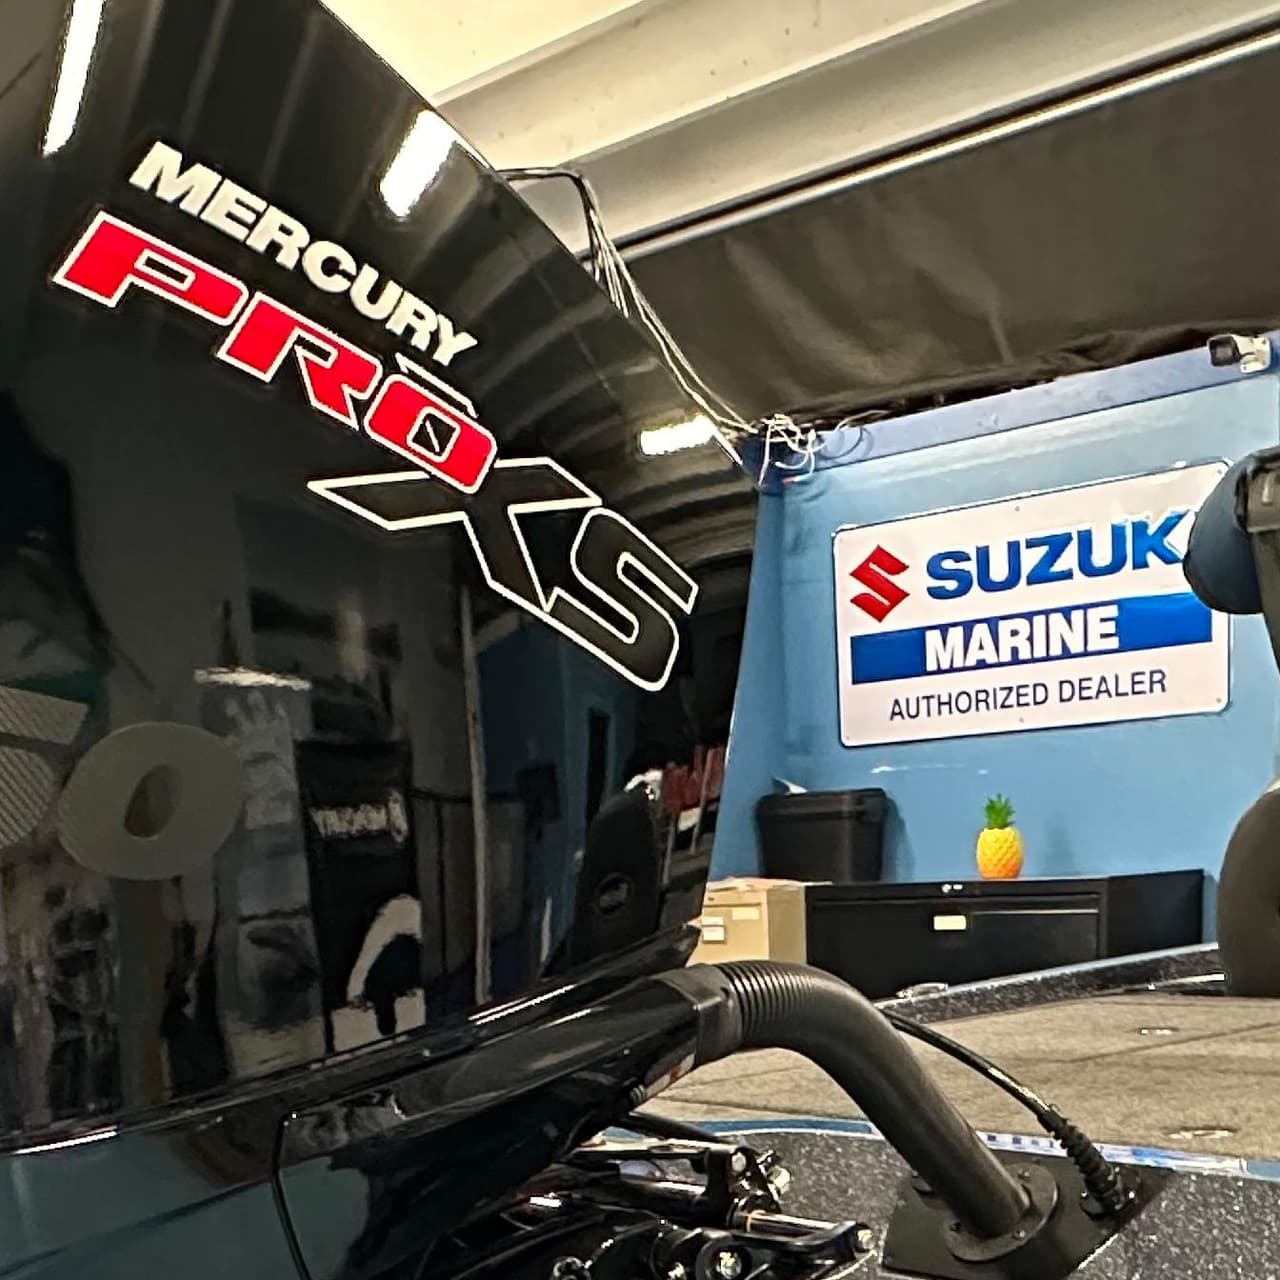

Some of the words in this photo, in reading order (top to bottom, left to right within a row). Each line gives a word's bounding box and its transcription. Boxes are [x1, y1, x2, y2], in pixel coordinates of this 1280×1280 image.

[128, 141, 477, 367] MERCURY
[52, 210, 497, 494] PRO
[307, 456, 698, 692] XS
[926, 510, 1194, 600] SUZUK
[889, 683, 1049, 721] AUTHORIZED
[1059, 669, 1167, 704] DEALER
[925, 604, 1119, 673] MARINE
